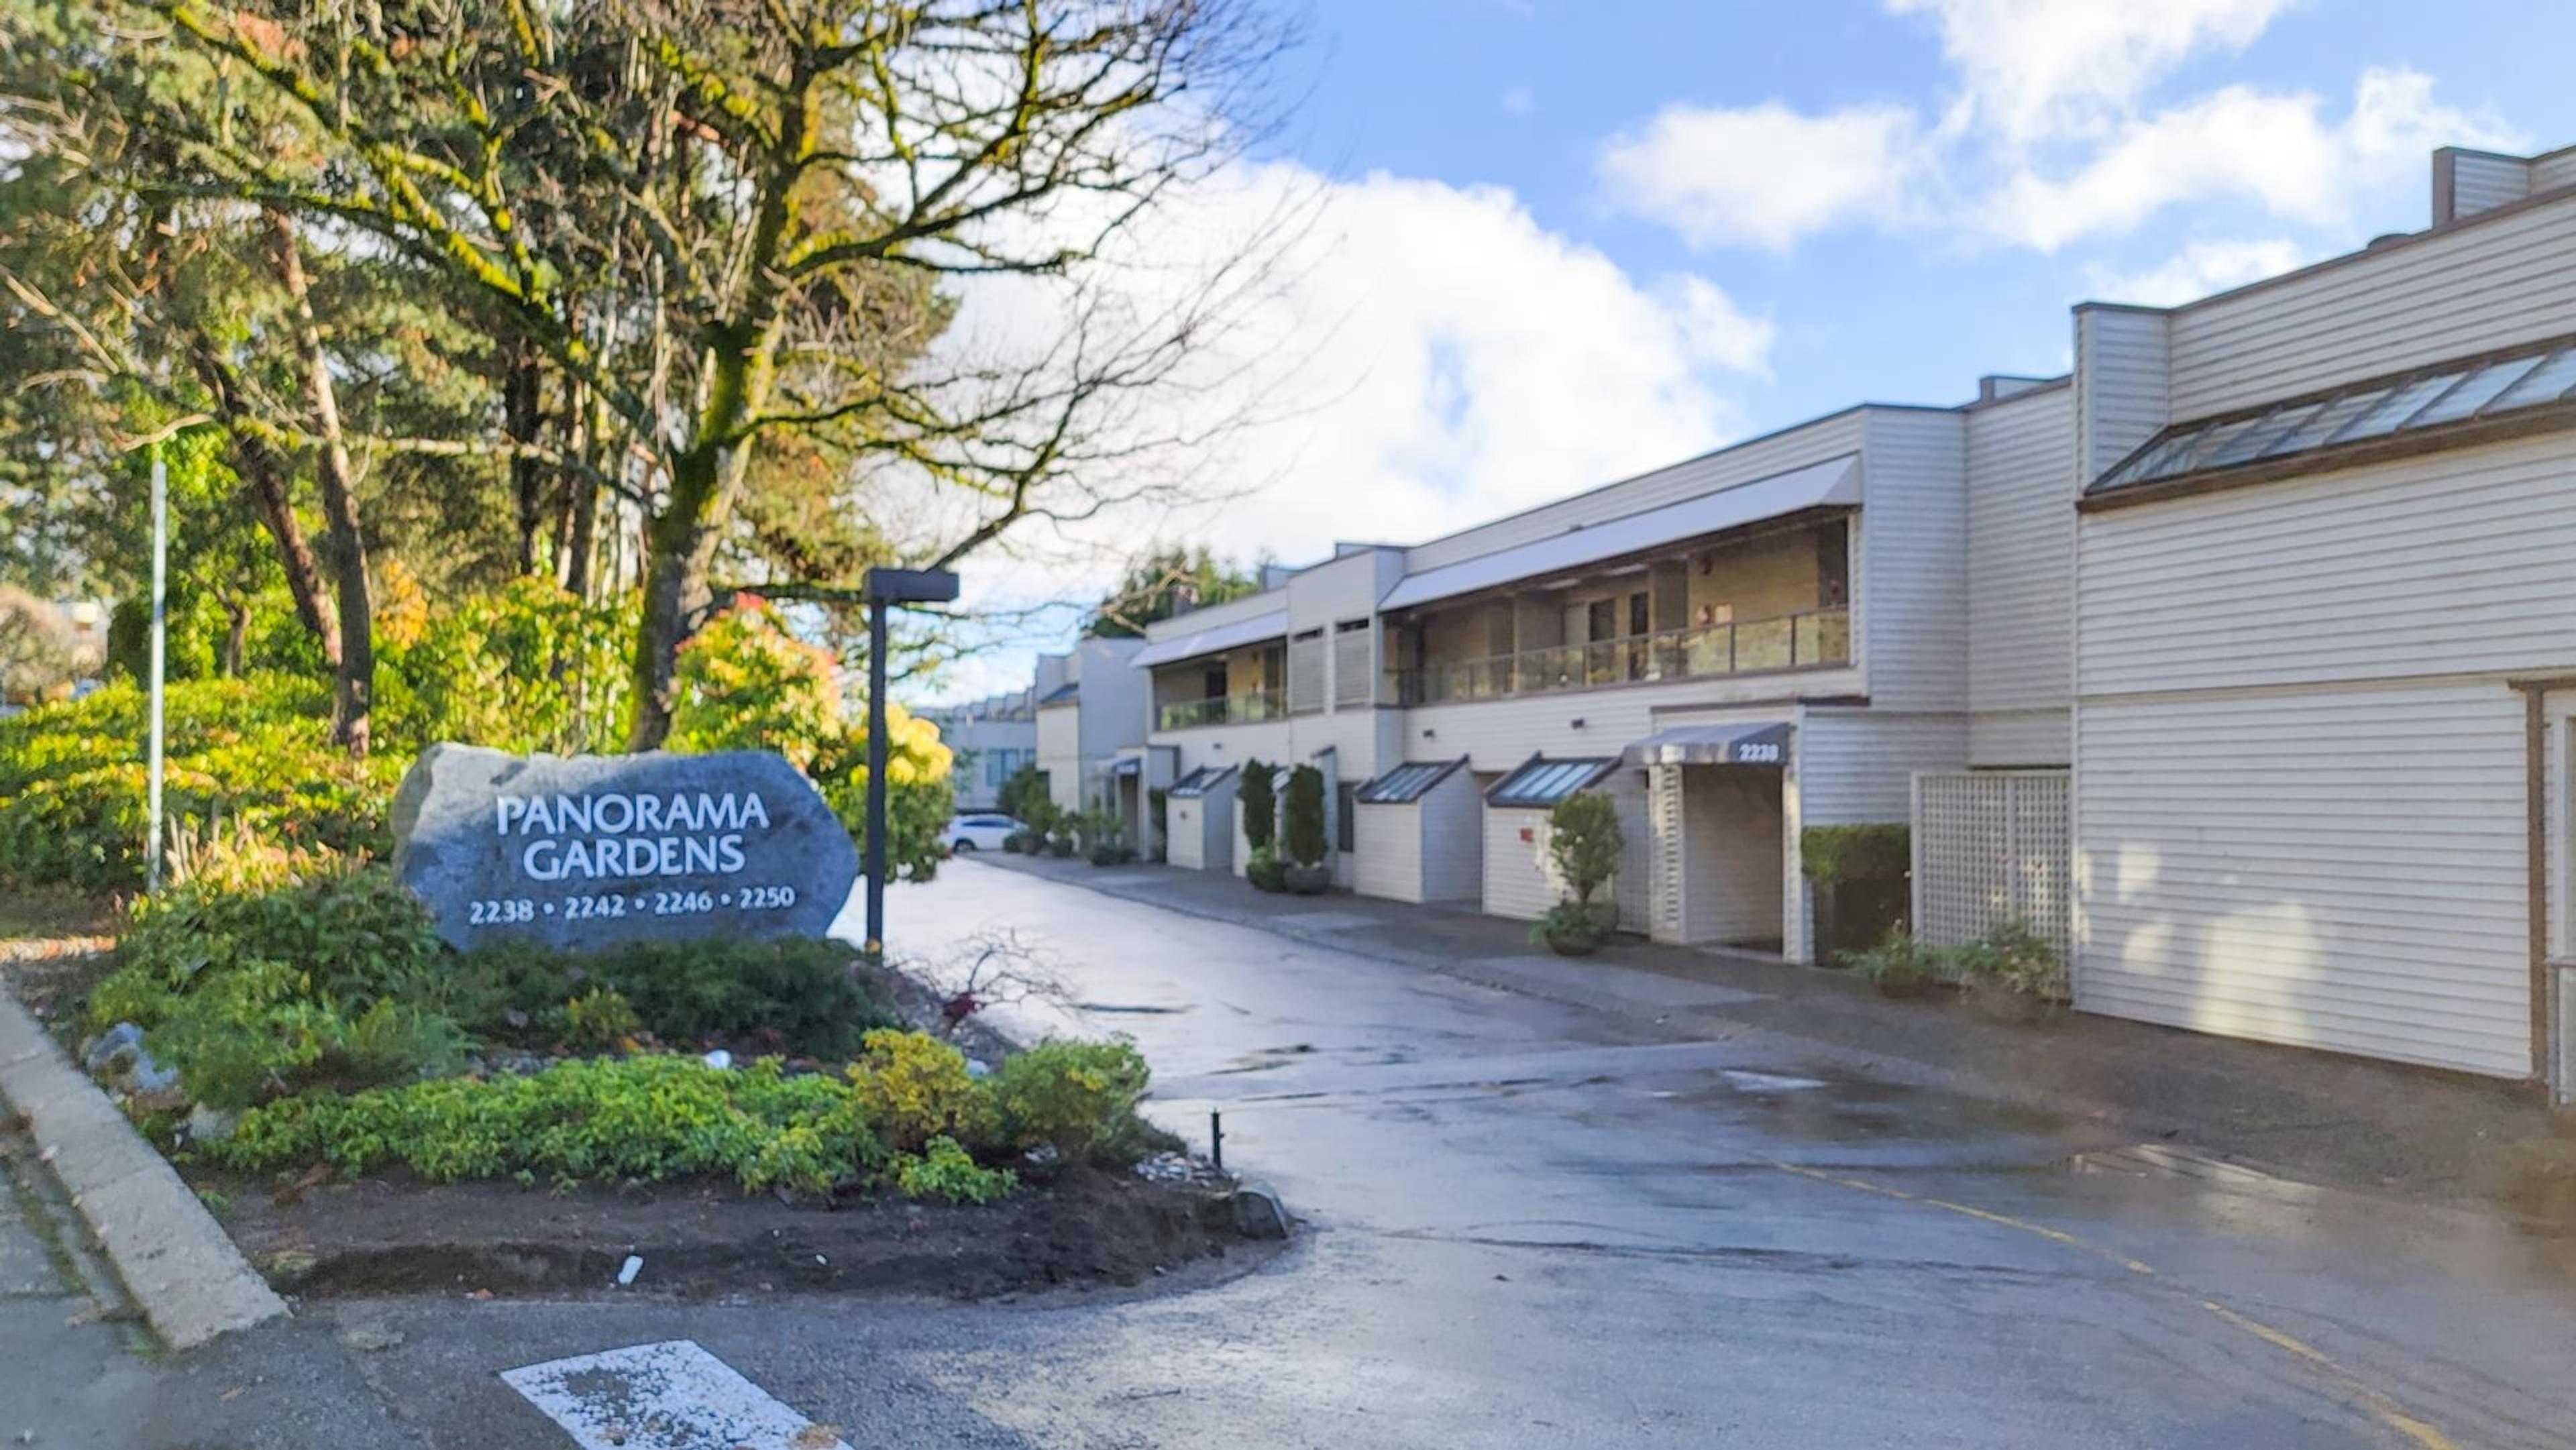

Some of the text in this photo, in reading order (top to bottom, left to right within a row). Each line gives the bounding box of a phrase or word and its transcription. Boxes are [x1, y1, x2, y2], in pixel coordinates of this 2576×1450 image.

[497, 792, 769, 835] PANORAMA
[524, 834, 746, 880] GARDENS
[470, 886, 796, 925] 2238 2242 2246 2250
